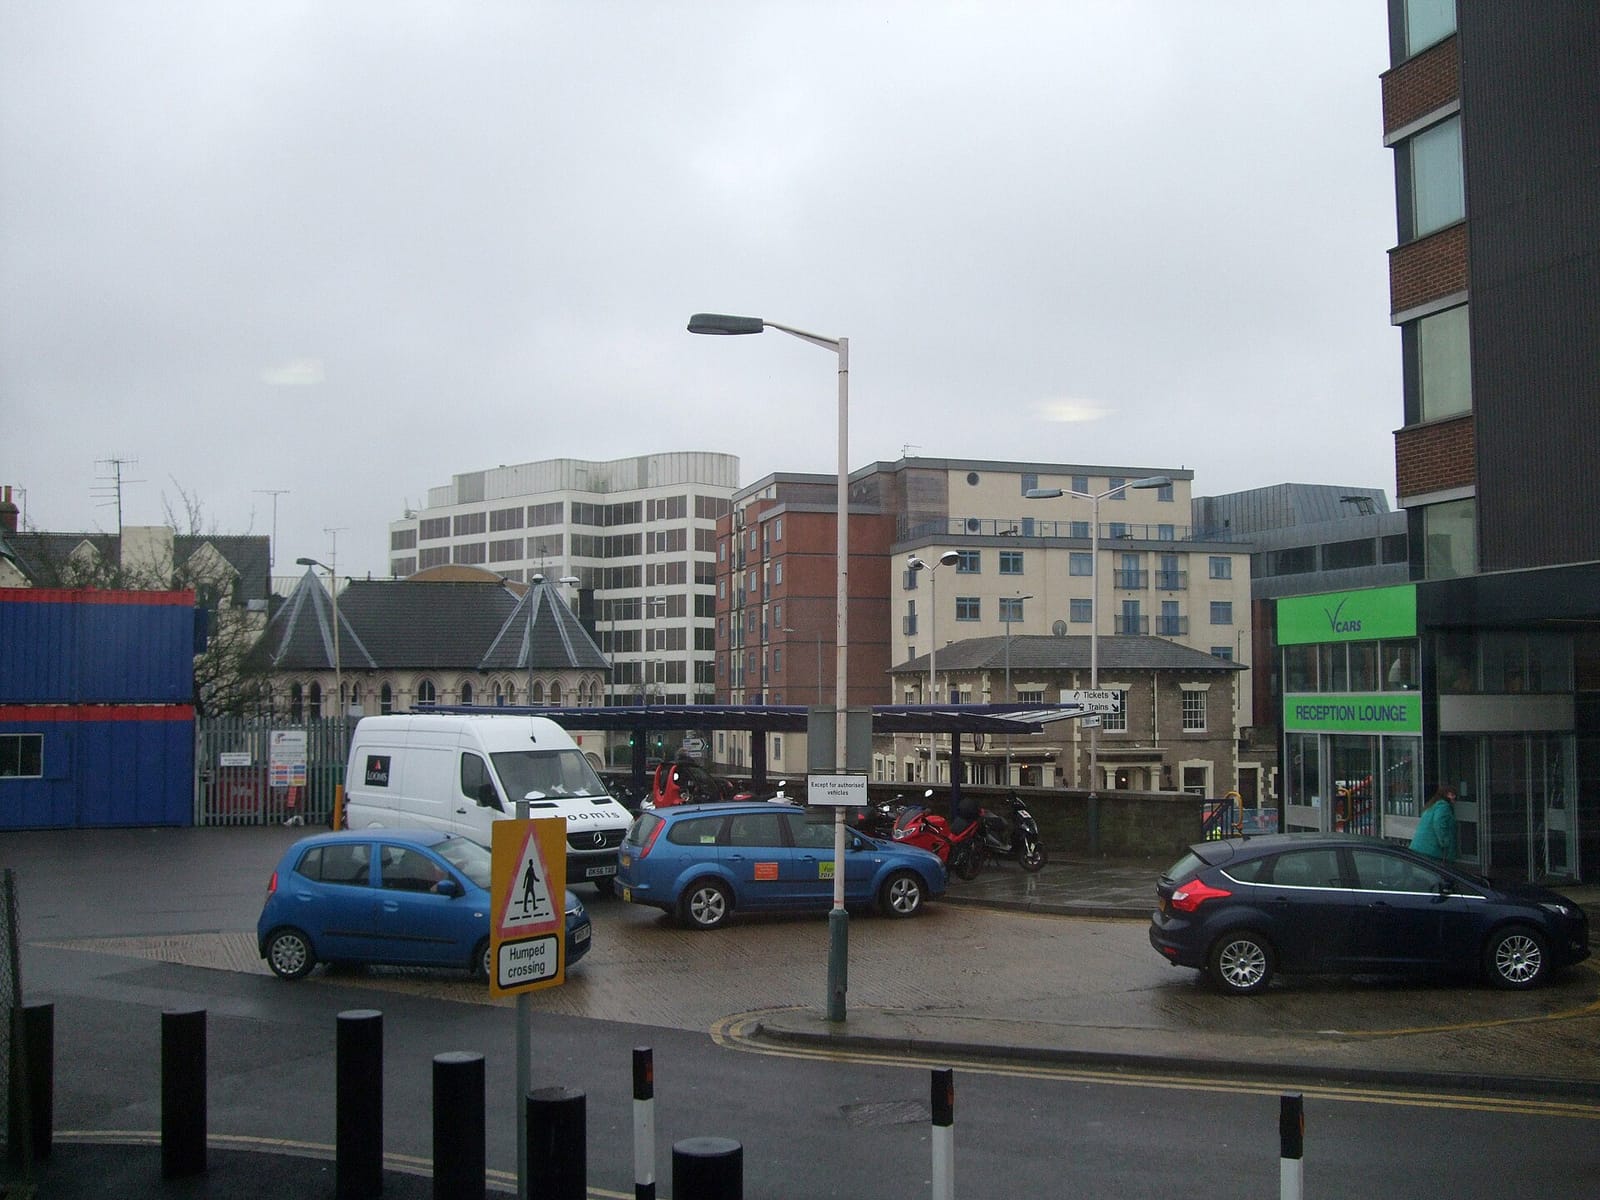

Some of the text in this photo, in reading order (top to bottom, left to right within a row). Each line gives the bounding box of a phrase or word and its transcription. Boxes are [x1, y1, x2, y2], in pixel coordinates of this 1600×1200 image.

[1083, 691, 1109, 700] Tickets
[1088, 703, 1109, 711] Trains
[1296, 705, 1408, 722] RECEPTION LOUNGE
[811, 781, 829, 789] Except
[837, 781, 865, 789] authorised
[555, 810, 621, 821] oomis
[510, 943, 545, 960] Humped
[508, 961, 546, 978] crossing
